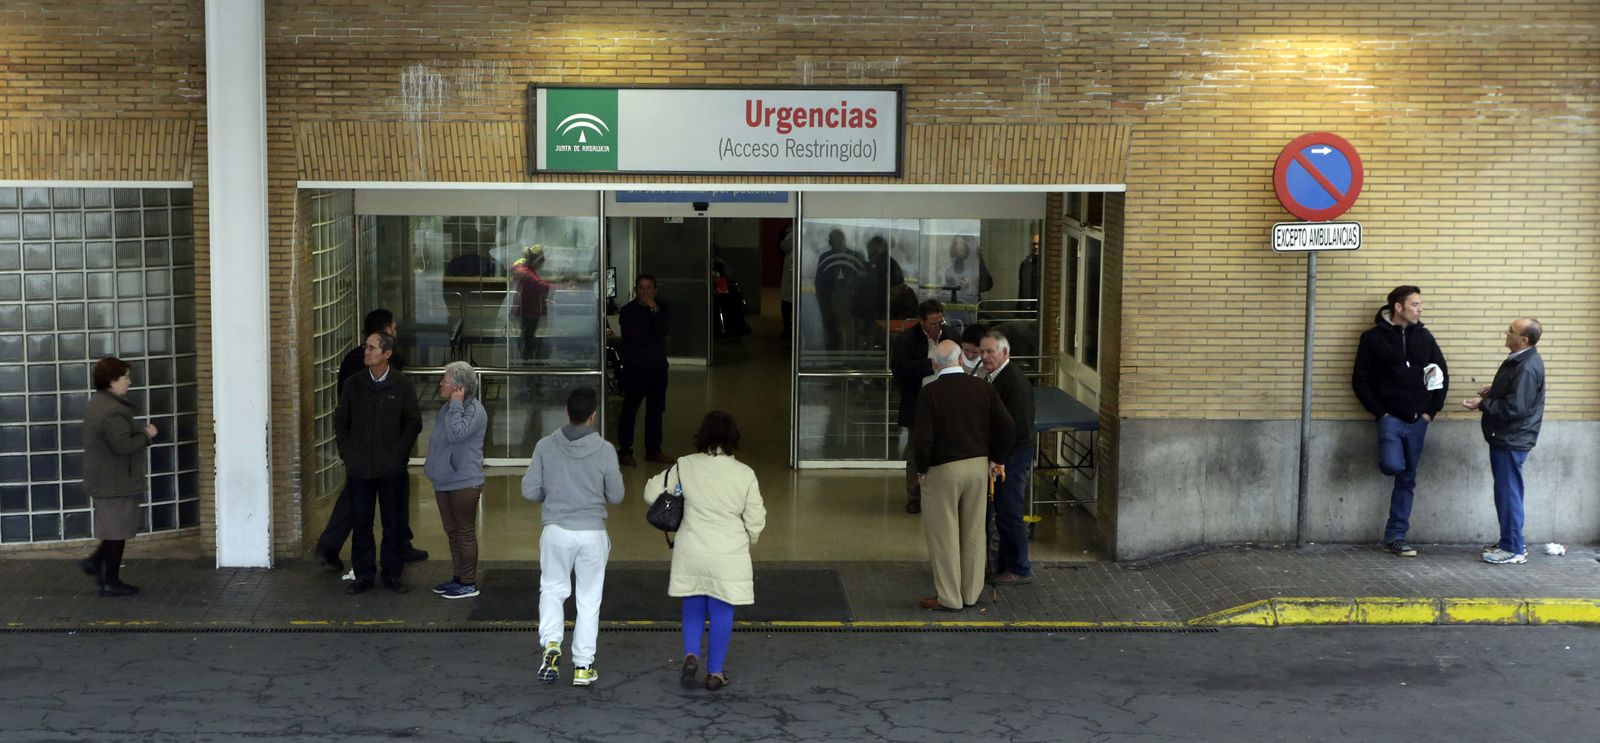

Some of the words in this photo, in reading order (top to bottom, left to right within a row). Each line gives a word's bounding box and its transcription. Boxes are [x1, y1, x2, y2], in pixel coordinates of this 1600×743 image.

[745, 99, 878, 135] Urgencias
[718, 137, 779, 161] (Acceso
[785, 138, 877, 162] Restringido)
[1276, 228, 1307, 247] EXCEPTO
[1309, 227, 1357, 246] AMBULANCIAS
